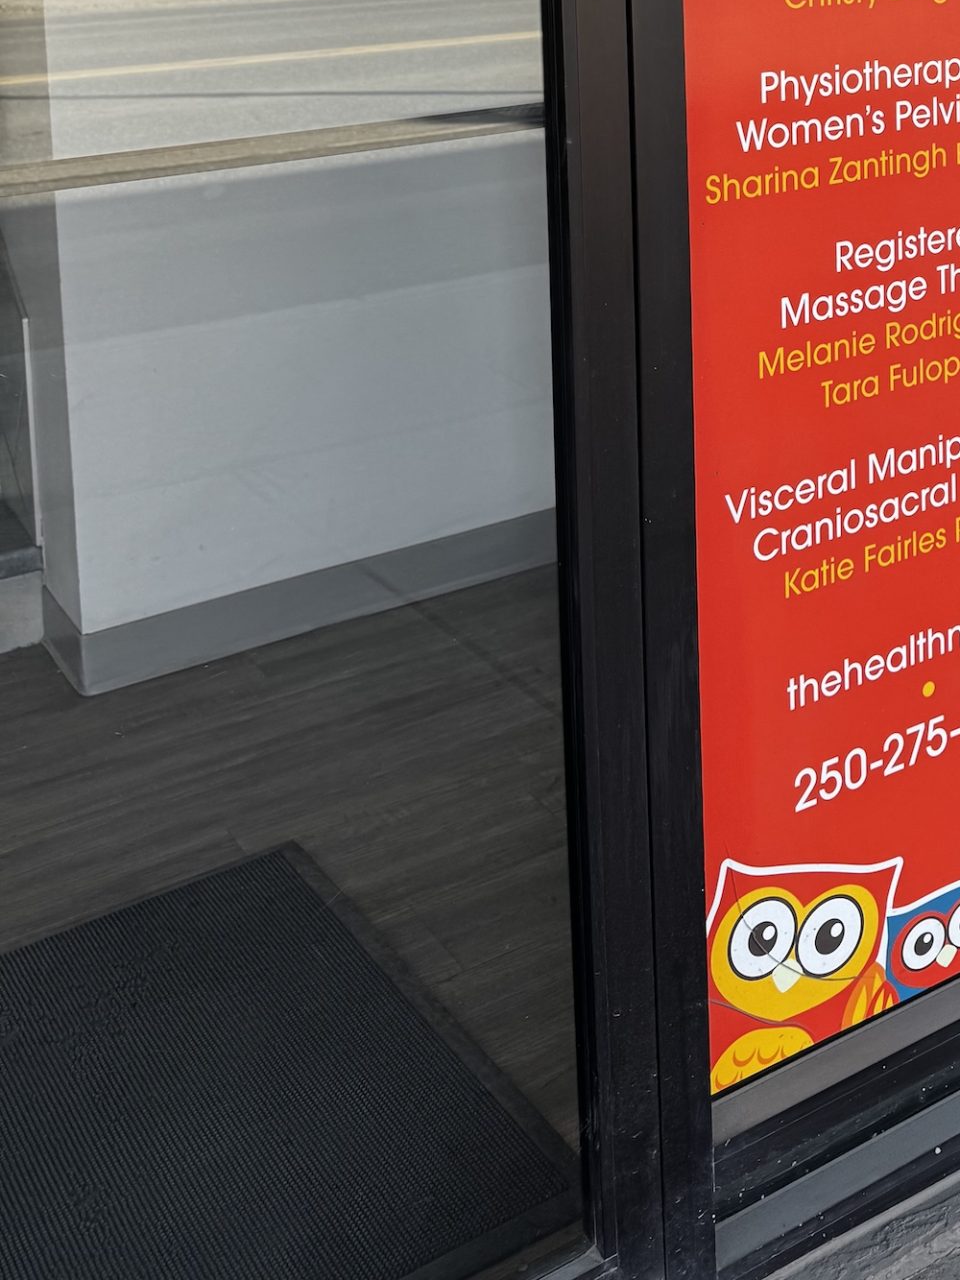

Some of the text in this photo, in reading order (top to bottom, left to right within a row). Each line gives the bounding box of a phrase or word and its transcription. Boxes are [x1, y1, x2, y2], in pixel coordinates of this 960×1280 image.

[705, 164, 819, 205] Sharina
[829, 143, 947, 186] Zantingh
[781, 275, 927, 329] Massage
[758, 331, 876, 379] Melanie
[822, 374, 879, 408] Tara
[889, 352, 960, 392] Fulop
[725, 460, 856, 524] Visceral
[753, 479, 956, 562] Craniosacral
[784, 557, 854, 599] Katie
[864, 526, 947, 573] Fairles
